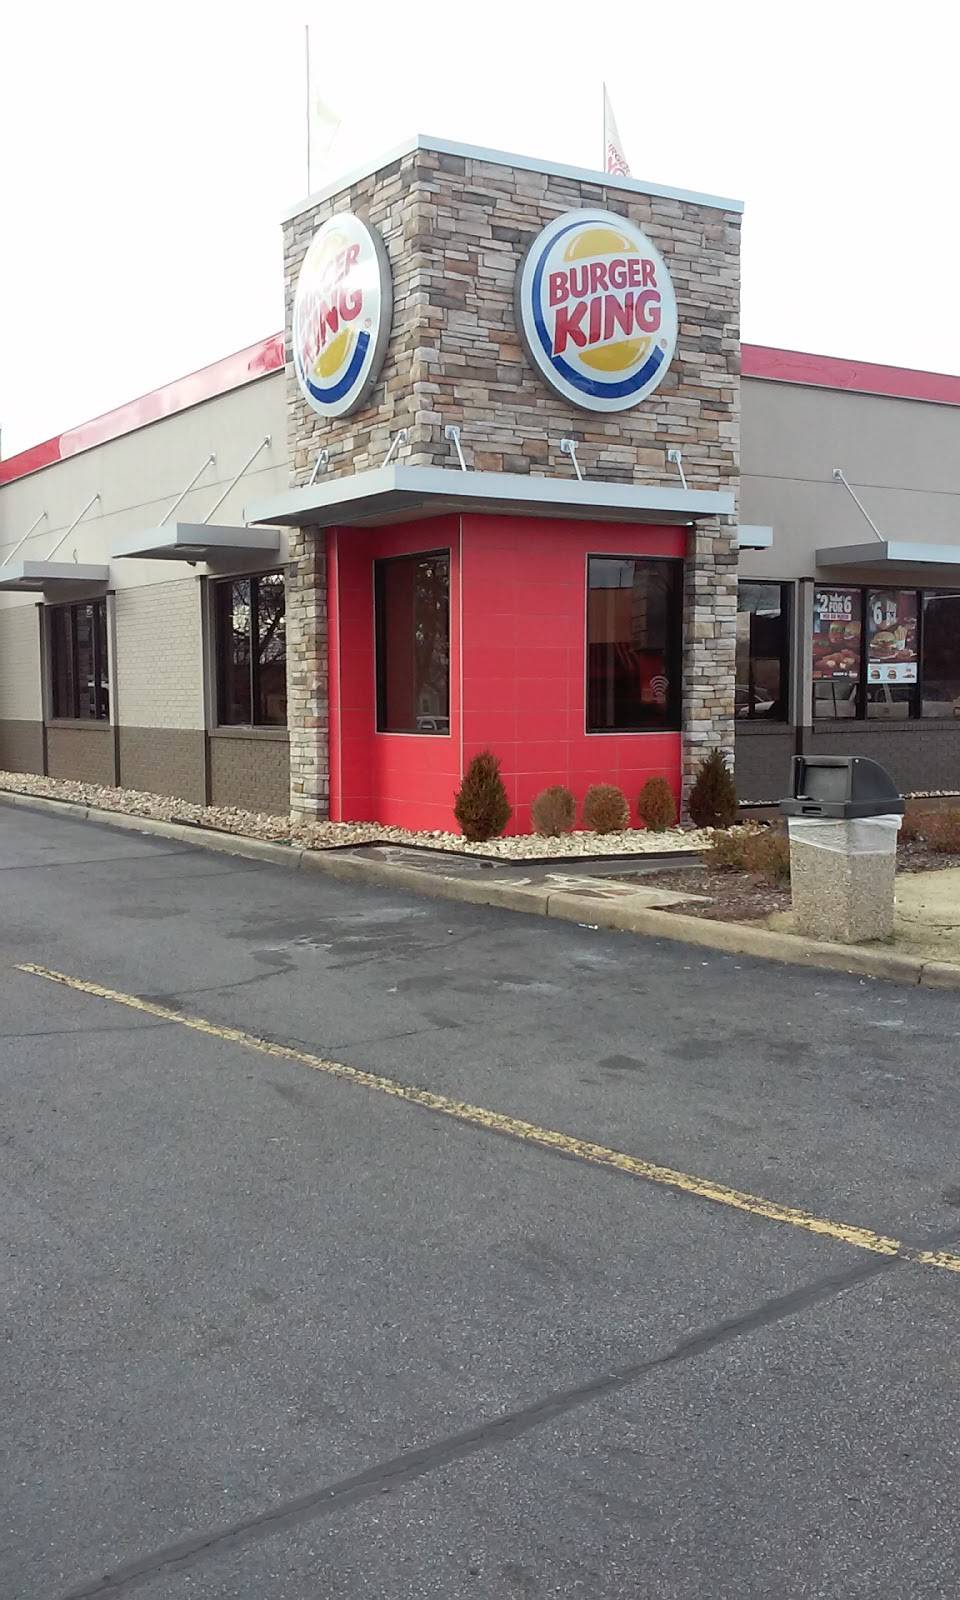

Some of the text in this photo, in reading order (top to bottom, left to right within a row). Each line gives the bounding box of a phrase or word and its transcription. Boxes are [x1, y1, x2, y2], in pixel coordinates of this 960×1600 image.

[549, 259, 658, 307] BURGER
[553, 289, 662, 355] KING
[829, 602, 843, 612] FOR
